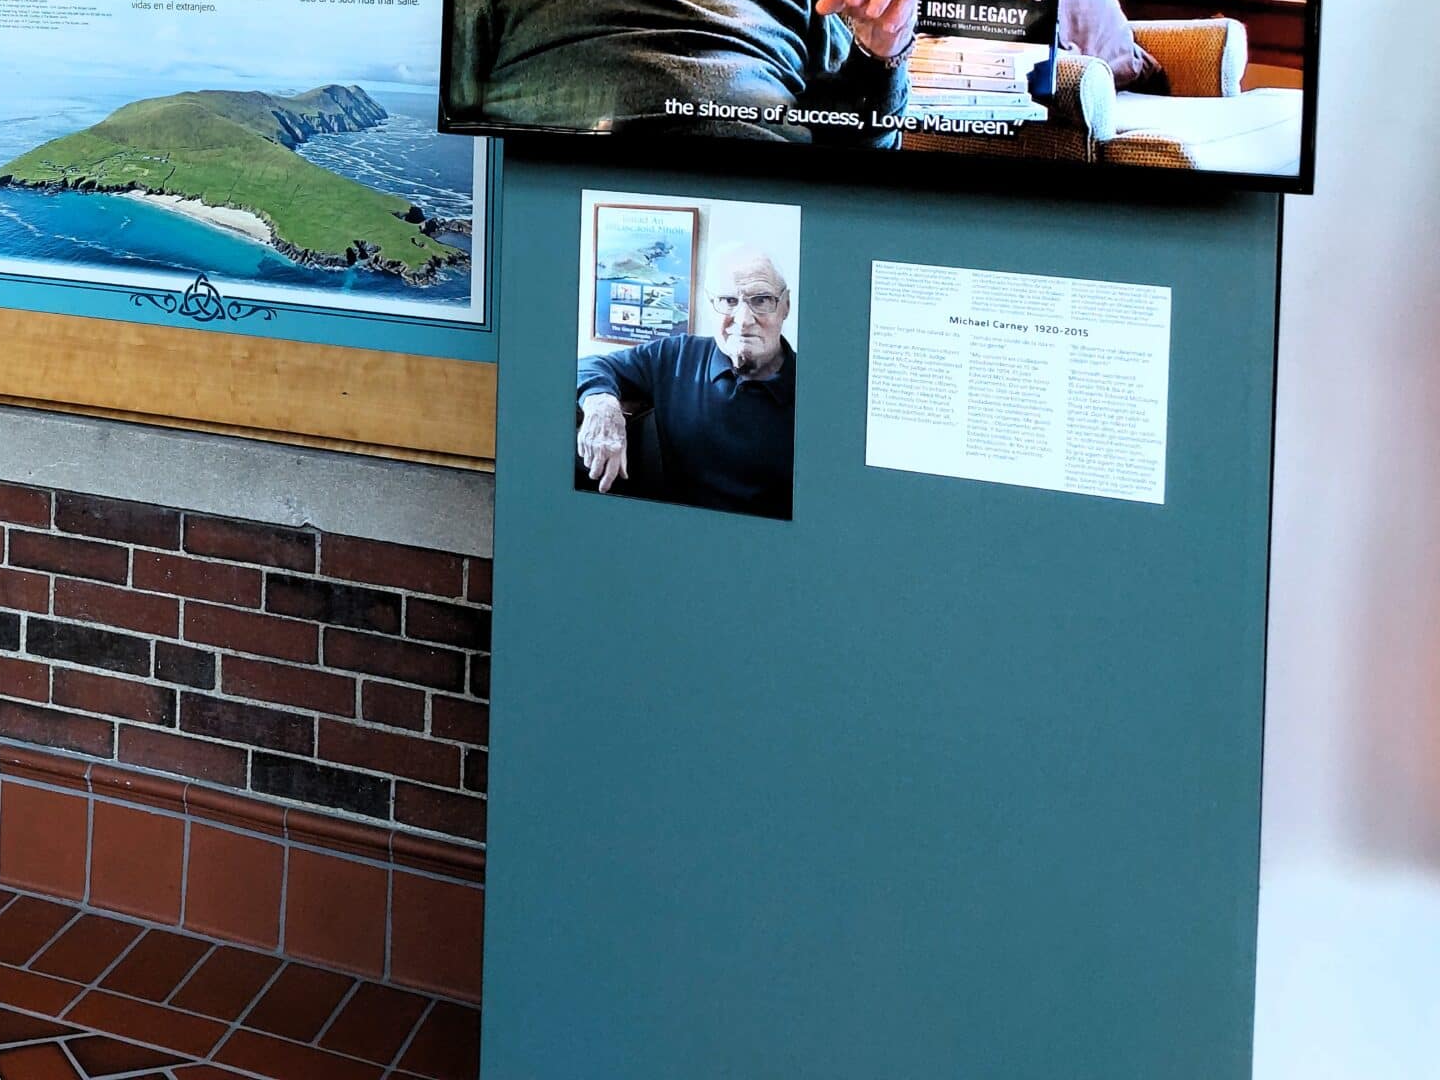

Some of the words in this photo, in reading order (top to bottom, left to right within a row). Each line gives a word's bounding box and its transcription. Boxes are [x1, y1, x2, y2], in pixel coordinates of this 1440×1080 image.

[153, 2, 164, 10] en
[166, 0, 173, 10] el
[926, 1, 965, 19] IRISH
[970, 5, 1028, 25] LEGACY
[665, 99, 693, 115] the
[699, 102, 757, 120] shores
[764, 105, 784, 120] of
[788, 110, 864, 130] success,
[872, 111, 917, 130] Love
[949, 316, 989, 327] Michael
[993, 321, 1028, 333] Carney
[1035, 325, 1088, 337] 1920-2015
